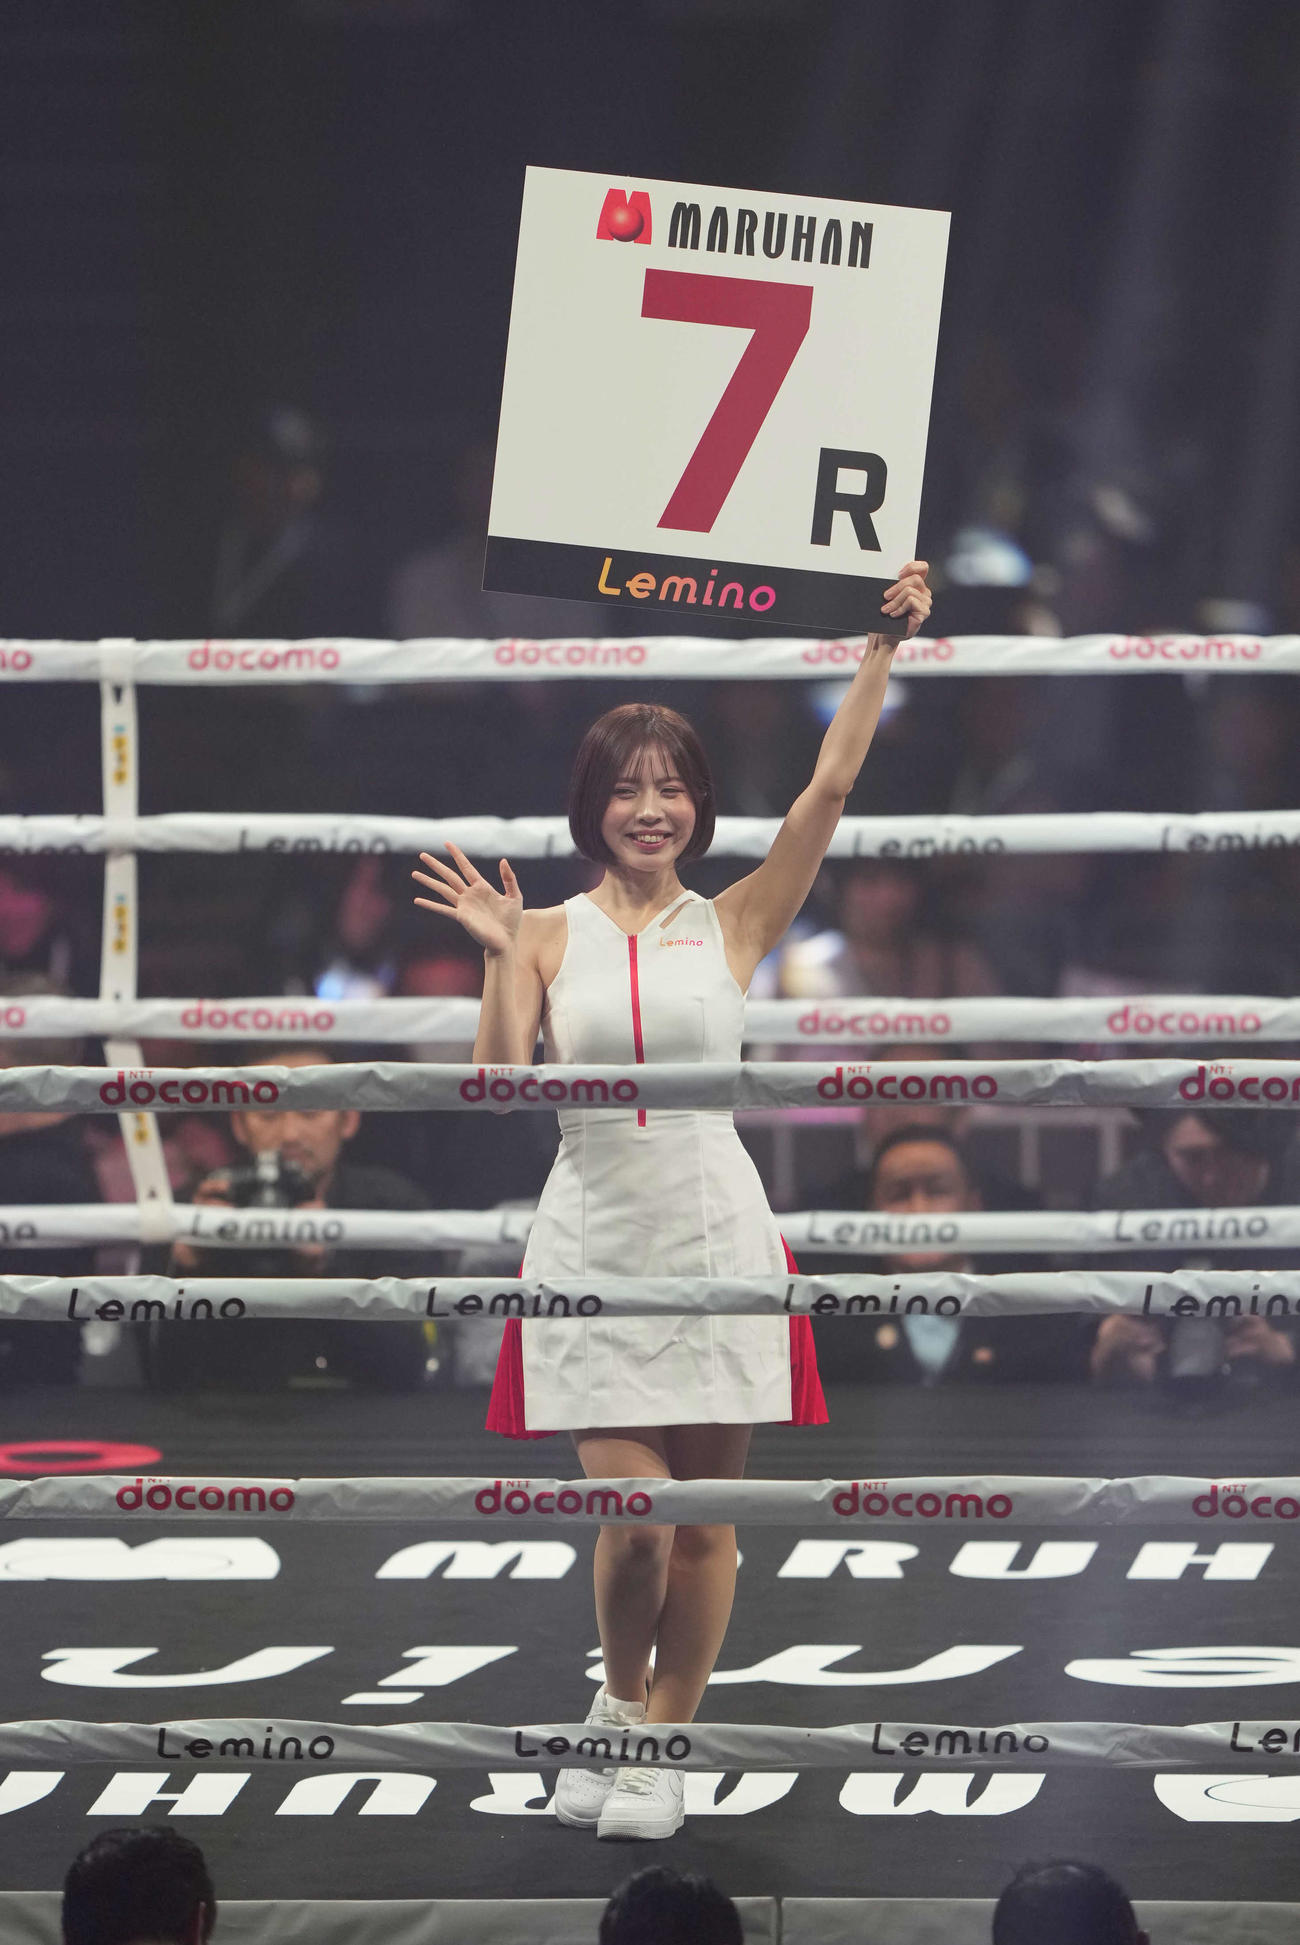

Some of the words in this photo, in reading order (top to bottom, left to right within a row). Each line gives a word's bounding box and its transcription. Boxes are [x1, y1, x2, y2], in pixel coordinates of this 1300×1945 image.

[668, 202, 874, 269] MARUHAN
[641, 268, 814, 533] 7
[811, 447, 888, 552] R
[598, 557, 776, 612] Lemino
[187, 640, 340, 671] docomo
[494, 640, 646, 665] docomo
[659, 936, 704, 947] Lemino
[181, 1001, 335, 1030] docomo
[797, 1008, 951, 1035] docomo
[1107, 1005, 1262, 1034] docomo
[129, 1070, 154, 1079] NTT
[459, 1068, 639, 1103] docomo
[490, 1067, 514, 1076] NTT
[817, 1066, 997, 1100] docomo
[847, 1065, 872, 1074] NTT
[1178, 1065, 1300, 1100] doco
[1209, 1065, 1234, 1074] NTT
[99, 1071, 280, 1105] docomo
[191, 1212, 344, 1241] Lemino
[1114, 1211, 1269, 1242] Lemino
[67, 1288, 246, 1320] Lemino
[426, 1283, 603, 1317] Lemino
[783, 1283, 961, 1315] Lemino
[116, 1478, 295, 1511] docomo
[474, 1480, 653, 1516] docomo
[506, 1480, 531, 1488] NTT
[832, 1482, 1013, 1518] docomo
[863, 1482, 888, 1490] NTT
[1222, 1484, 1248, 1493] NTT
[157, 1726, 335, 1760] Lemino
[515, 1729, 691, 1761] Lemino
[872, 1723, 1049, 1756] Lemino
